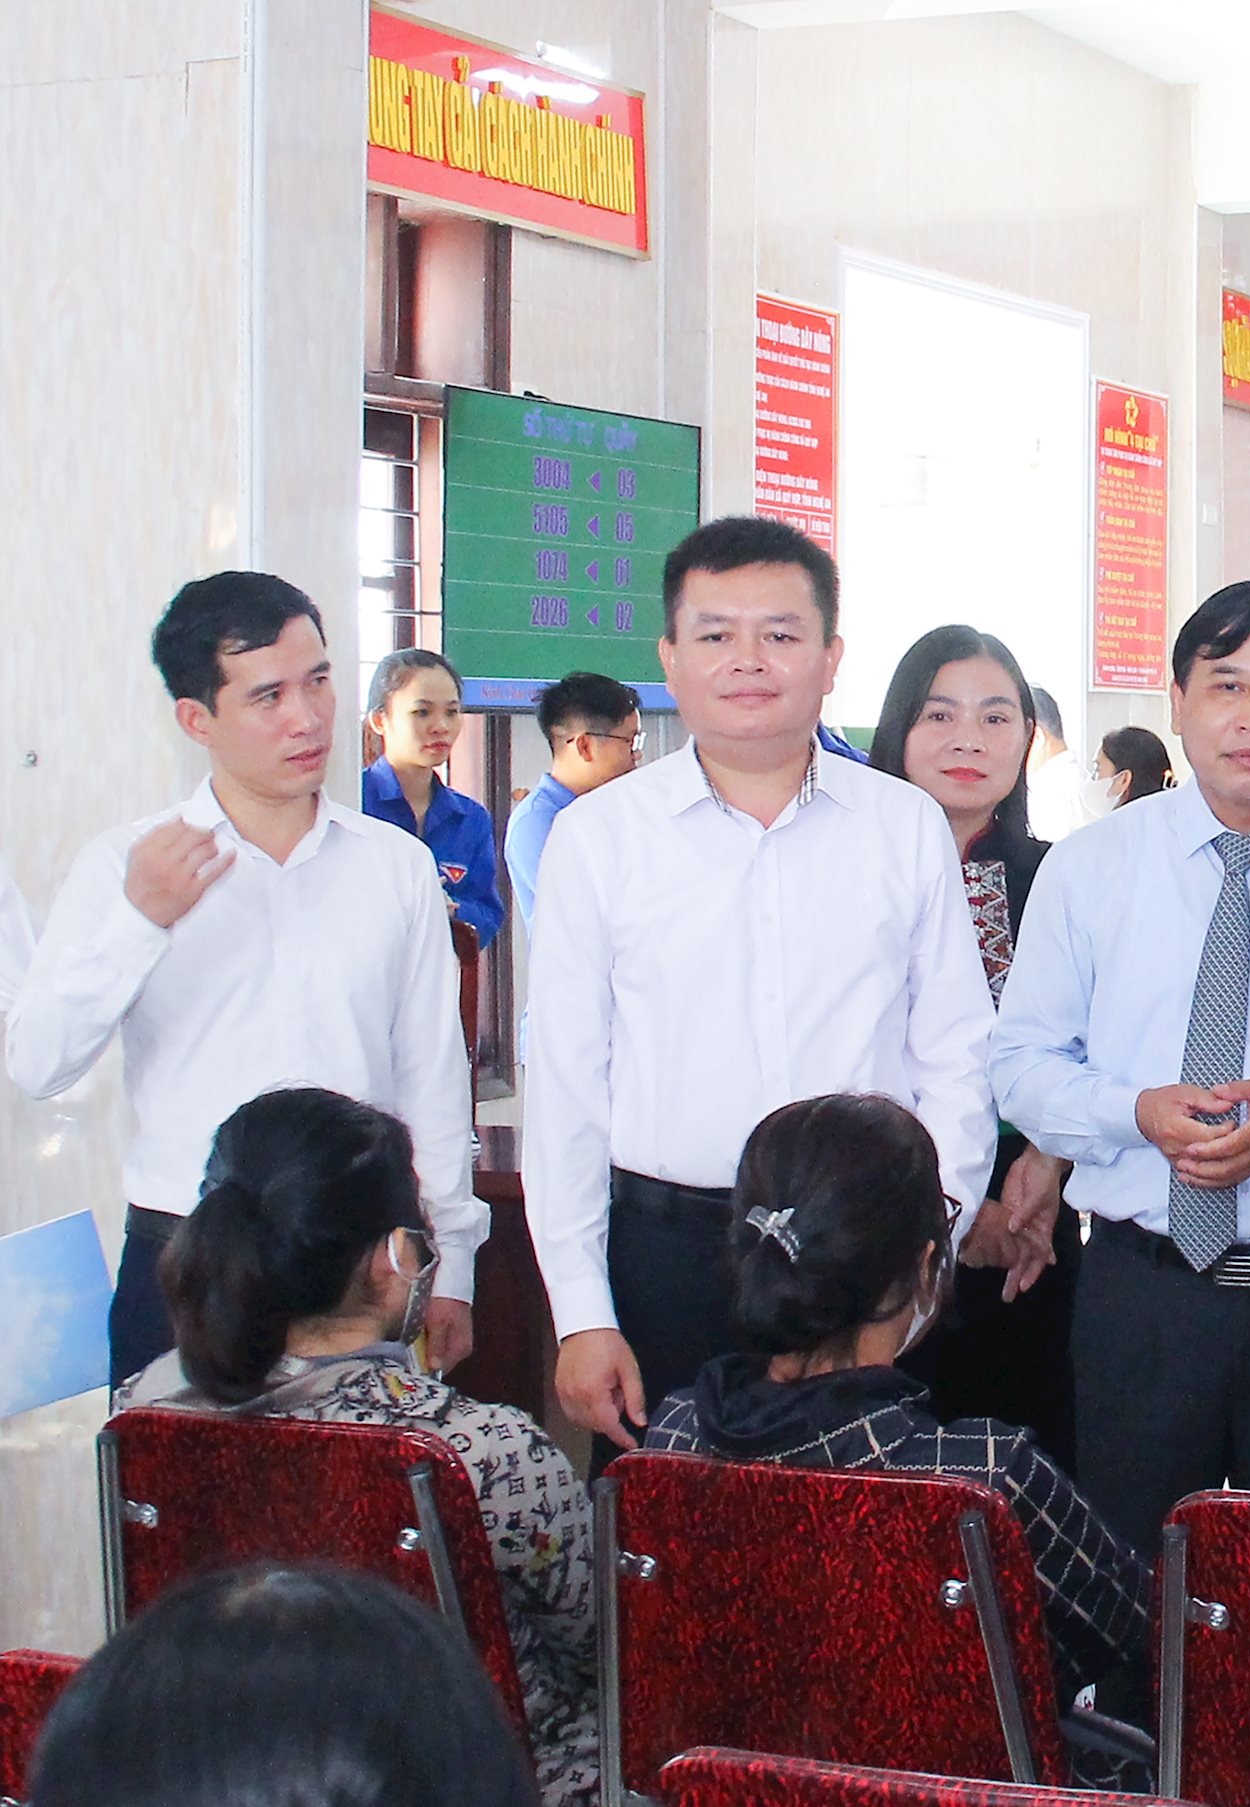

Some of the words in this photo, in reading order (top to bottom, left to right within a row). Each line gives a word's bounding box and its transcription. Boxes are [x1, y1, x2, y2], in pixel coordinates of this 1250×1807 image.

[410, 67, 444, 163] TAY
[444, 56, 481, 173] CẢI
[481, 81, 533, 187] CÁCH
[534, 95, 582, 201] HÀNH
[583, 114, 635, 215] CHÍNH
[533, 455, 571, 490] 3004
[616, 467, 636, 499] 03
[532, 502, 568, 536] 5105
[614, 512, 634, 542] 05
[535, 550, 568, 583] 1074
[614, 558, 632, 587] 01
[530, 597, 569, 627] 2026
[614, 601, 633, 631] 02
